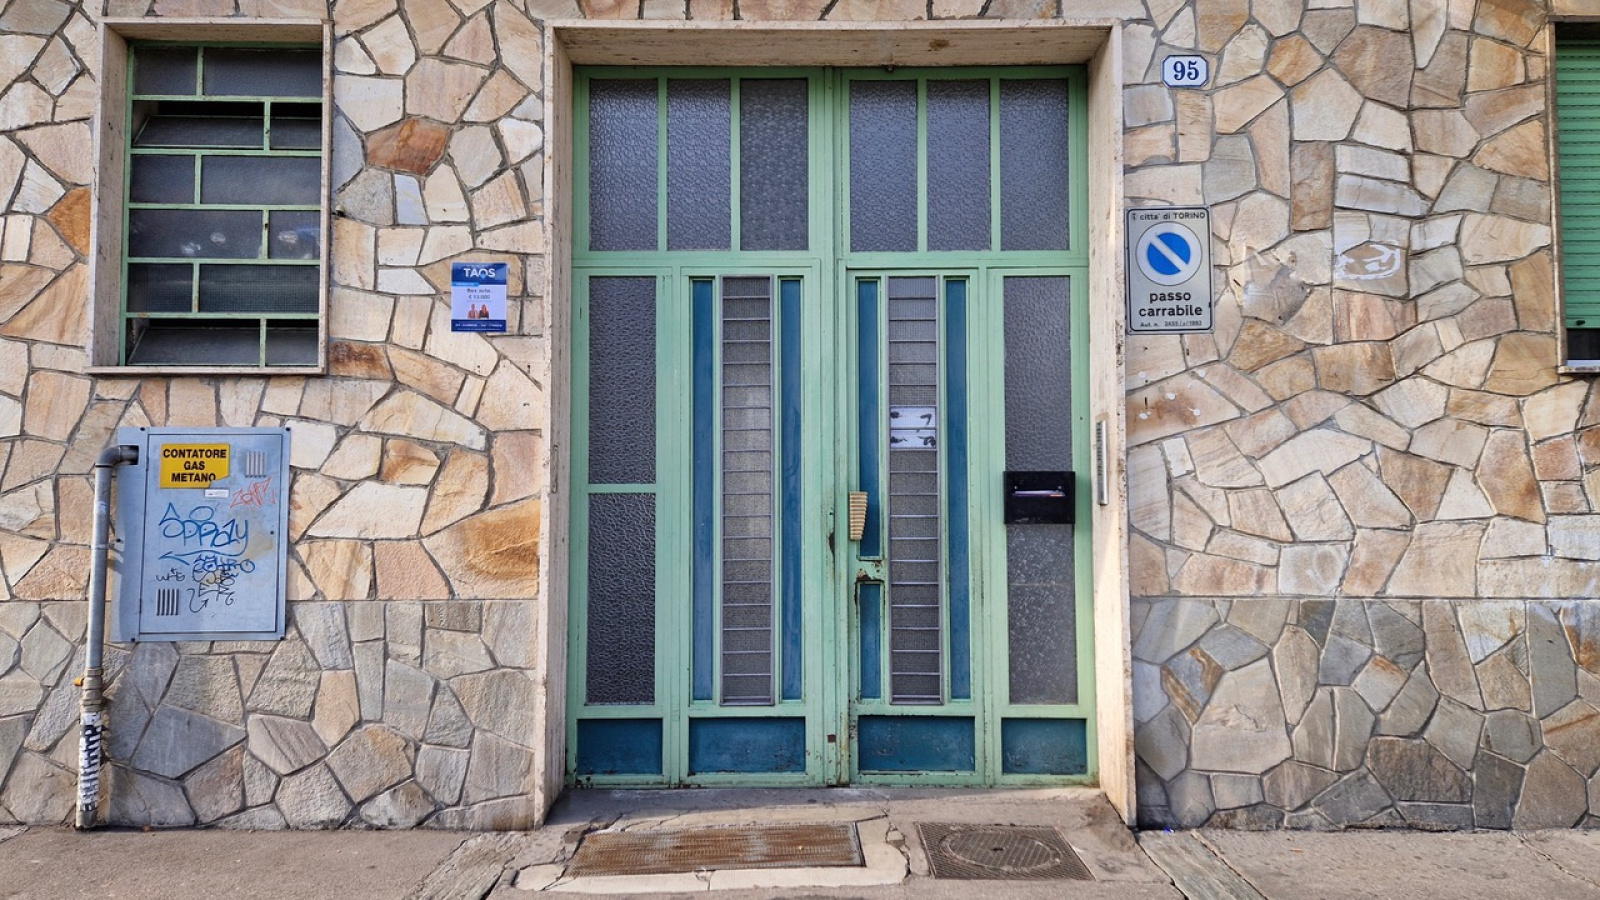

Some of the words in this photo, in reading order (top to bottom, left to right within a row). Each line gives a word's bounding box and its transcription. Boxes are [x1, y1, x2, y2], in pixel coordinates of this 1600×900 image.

[1173, 60, 1200, 81] 95
[1173, 212, 1206, 220] TORINO
[463, 268, 496, 278] TAOS
[1149, 292, 1192, 304] passo
[1138, 305, 1203, 317] carrabile
[163, 449, 227, 458] CONTATORE
[184, 461, 205, 470] GAS
[171, 473, 216, 482] METANO
